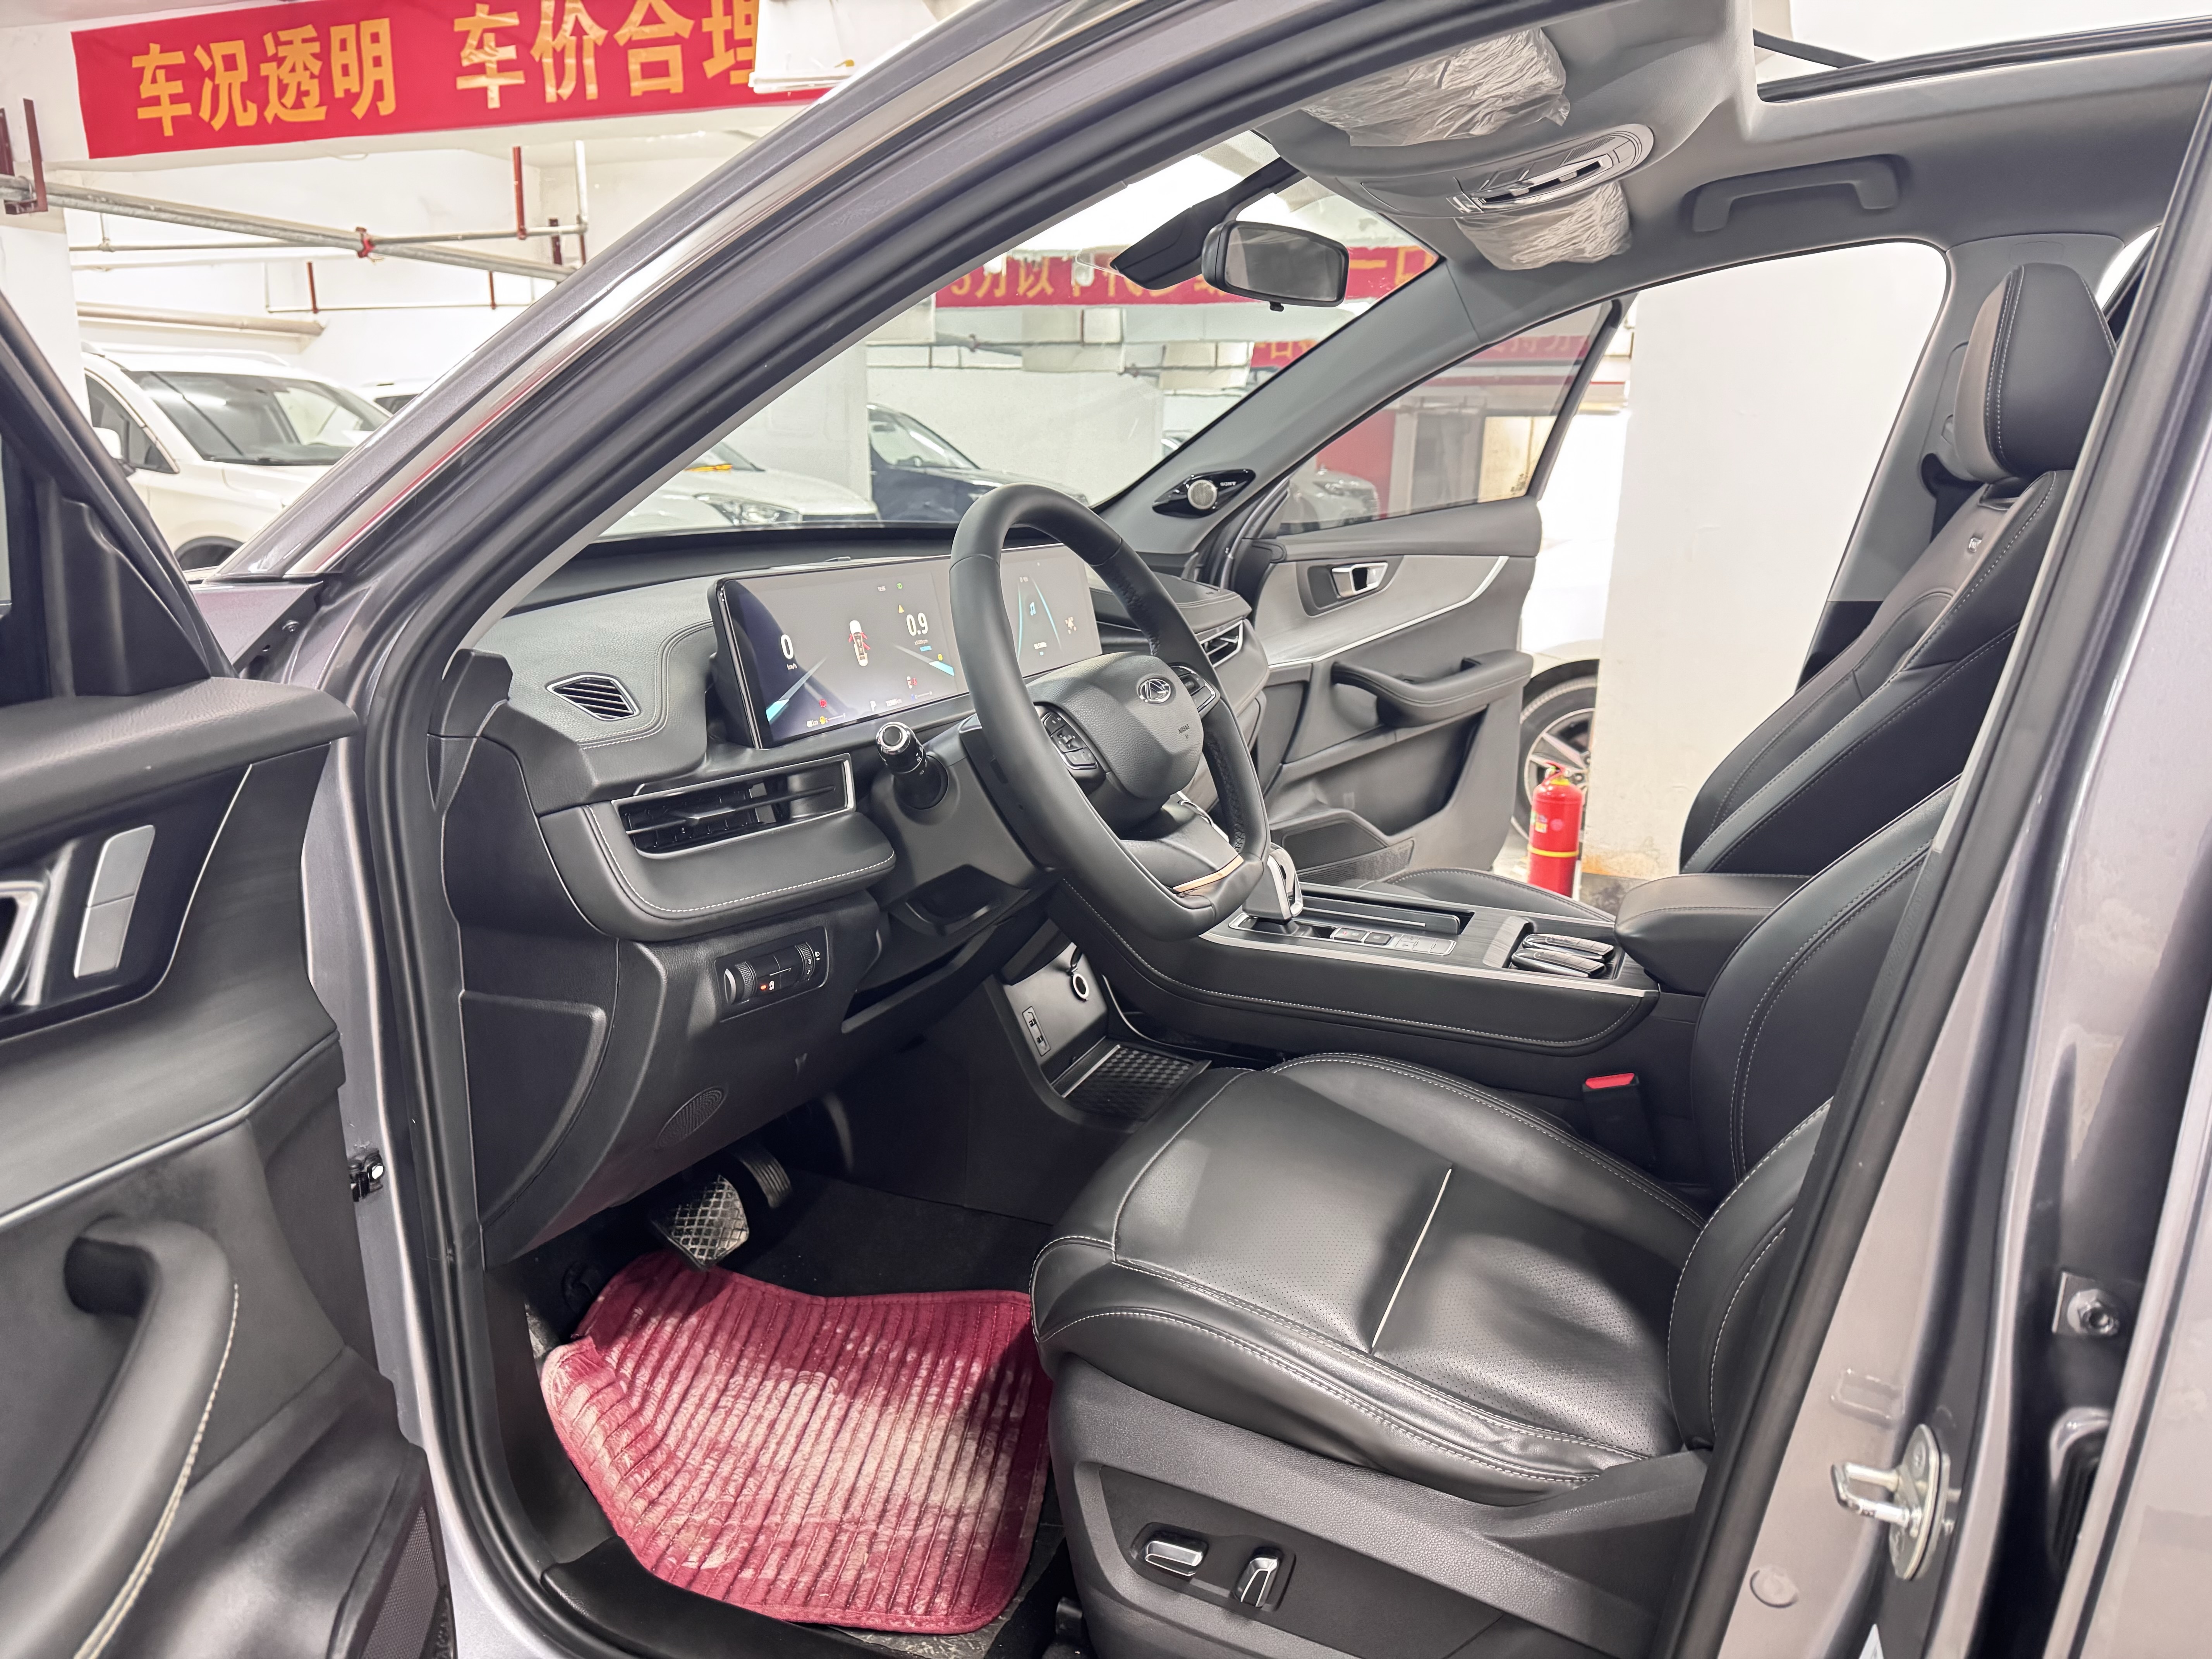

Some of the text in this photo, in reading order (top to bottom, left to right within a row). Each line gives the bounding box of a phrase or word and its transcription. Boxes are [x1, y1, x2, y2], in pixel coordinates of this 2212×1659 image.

[132, 17, 397, 137] 车况透明
[906, 612, 928, 636] 0.9
[781, 634, 794, 659] 0
[870, 701, 876, 712] P
